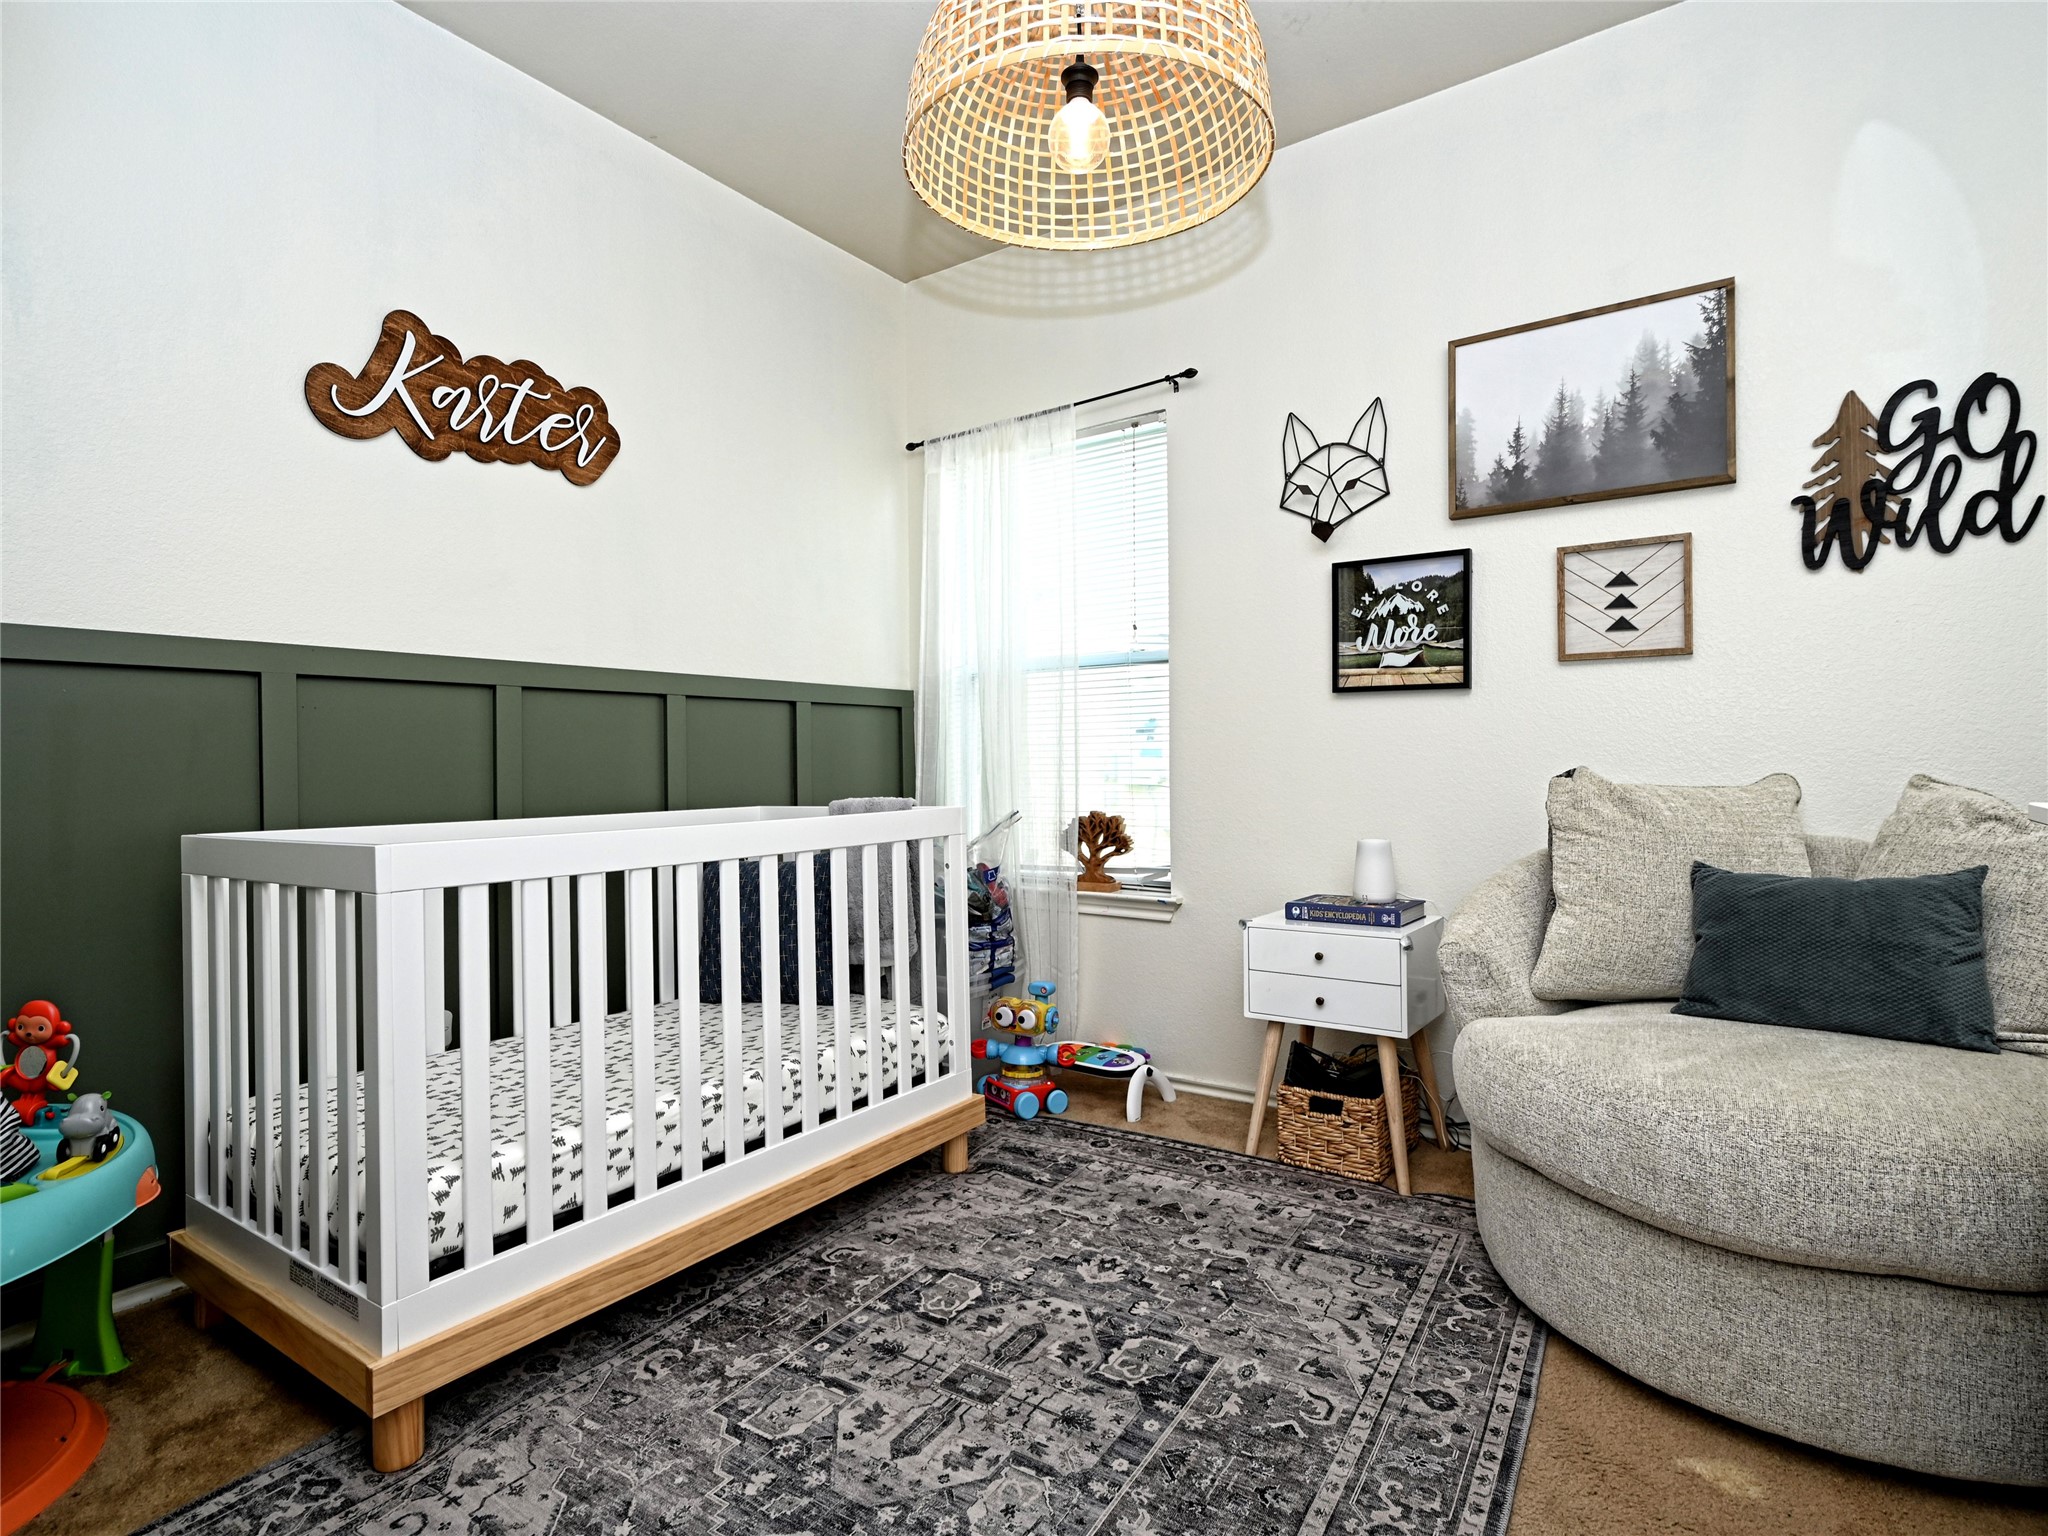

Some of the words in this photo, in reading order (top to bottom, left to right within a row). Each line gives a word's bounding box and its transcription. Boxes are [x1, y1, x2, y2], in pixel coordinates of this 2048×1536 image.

[331, 330, 607, 468] Karter
[1877, 372, 2021, 495] GO
[1355, 613, 1439, 653] More
[1324, 911, 1367, 921] ENCYCLOPEDIA
